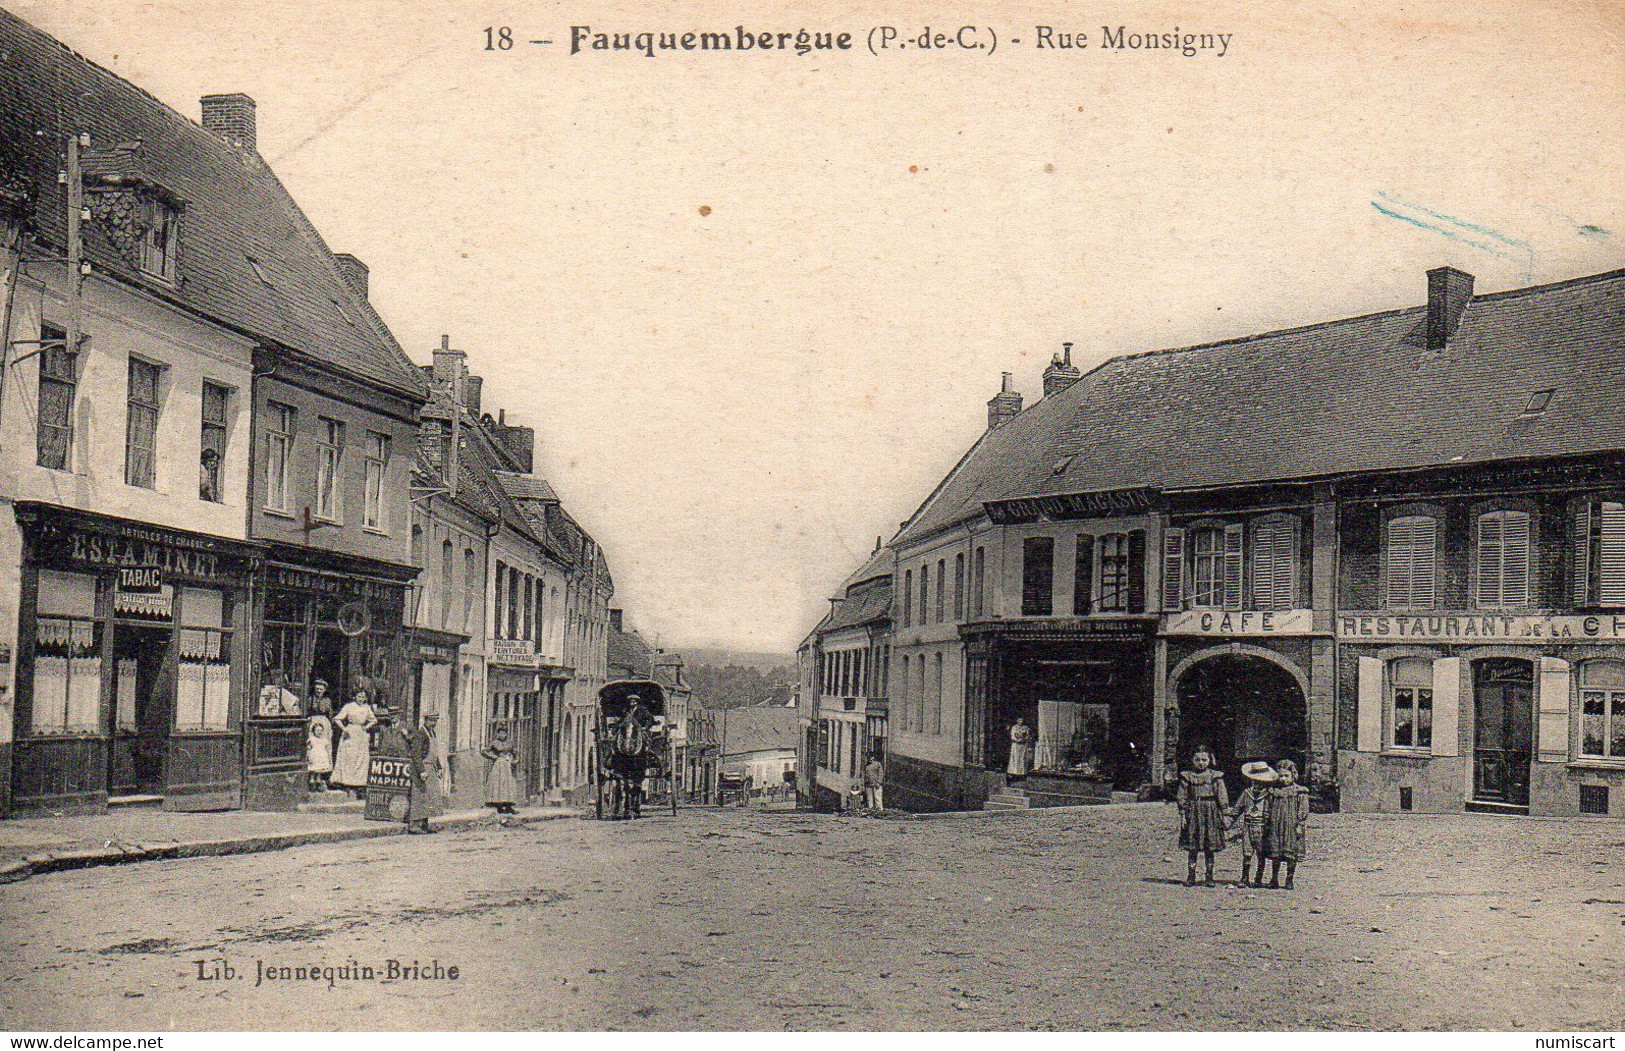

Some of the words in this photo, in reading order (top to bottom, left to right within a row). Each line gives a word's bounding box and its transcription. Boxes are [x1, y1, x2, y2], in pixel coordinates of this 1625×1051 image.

[120, 527, 161, 542] ARTICLES
[69, 534, 219, 578] ESTAMINET
[120, 568, 160, 587] TABAC
[1343, 617, 1515, 636] RESTAURANT
[1521, 623, 1541, 637] DE
[1551, 623, 1572, 637] LA
[370, 776, 411, 787] NAPHTA
